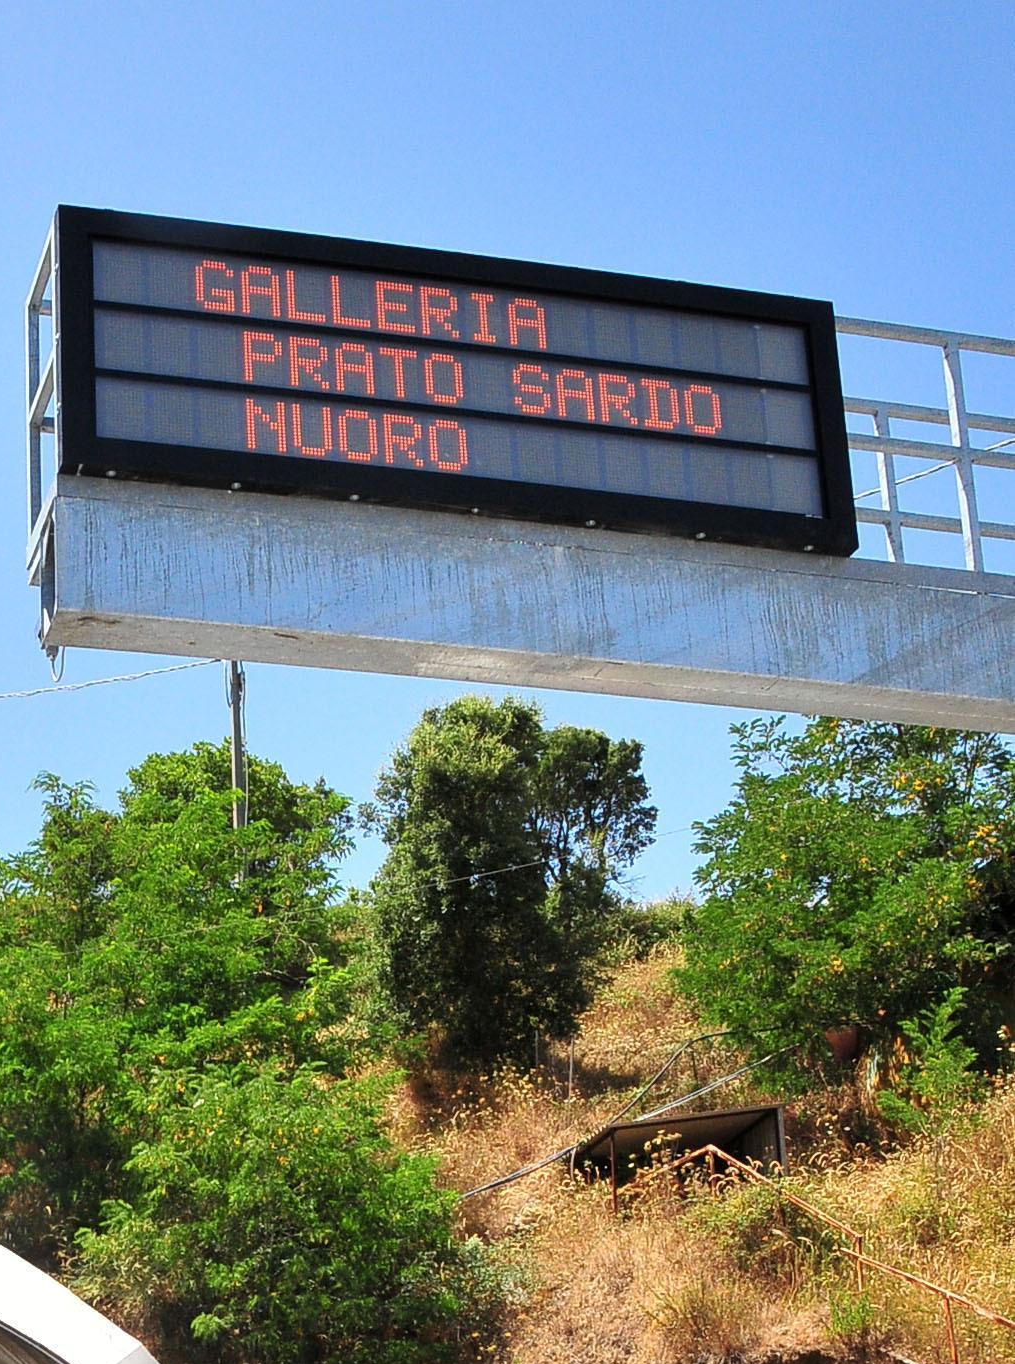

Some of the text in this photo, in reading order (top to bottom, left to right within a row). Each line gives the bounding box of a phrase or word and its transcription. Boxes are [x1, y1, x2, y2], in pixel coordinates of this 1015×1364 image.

[195, 259, 548, 350] GALLERIA
[243, 330, 723, 435] PRATO SARDO
[245, 398, 469, 472] NUORO
